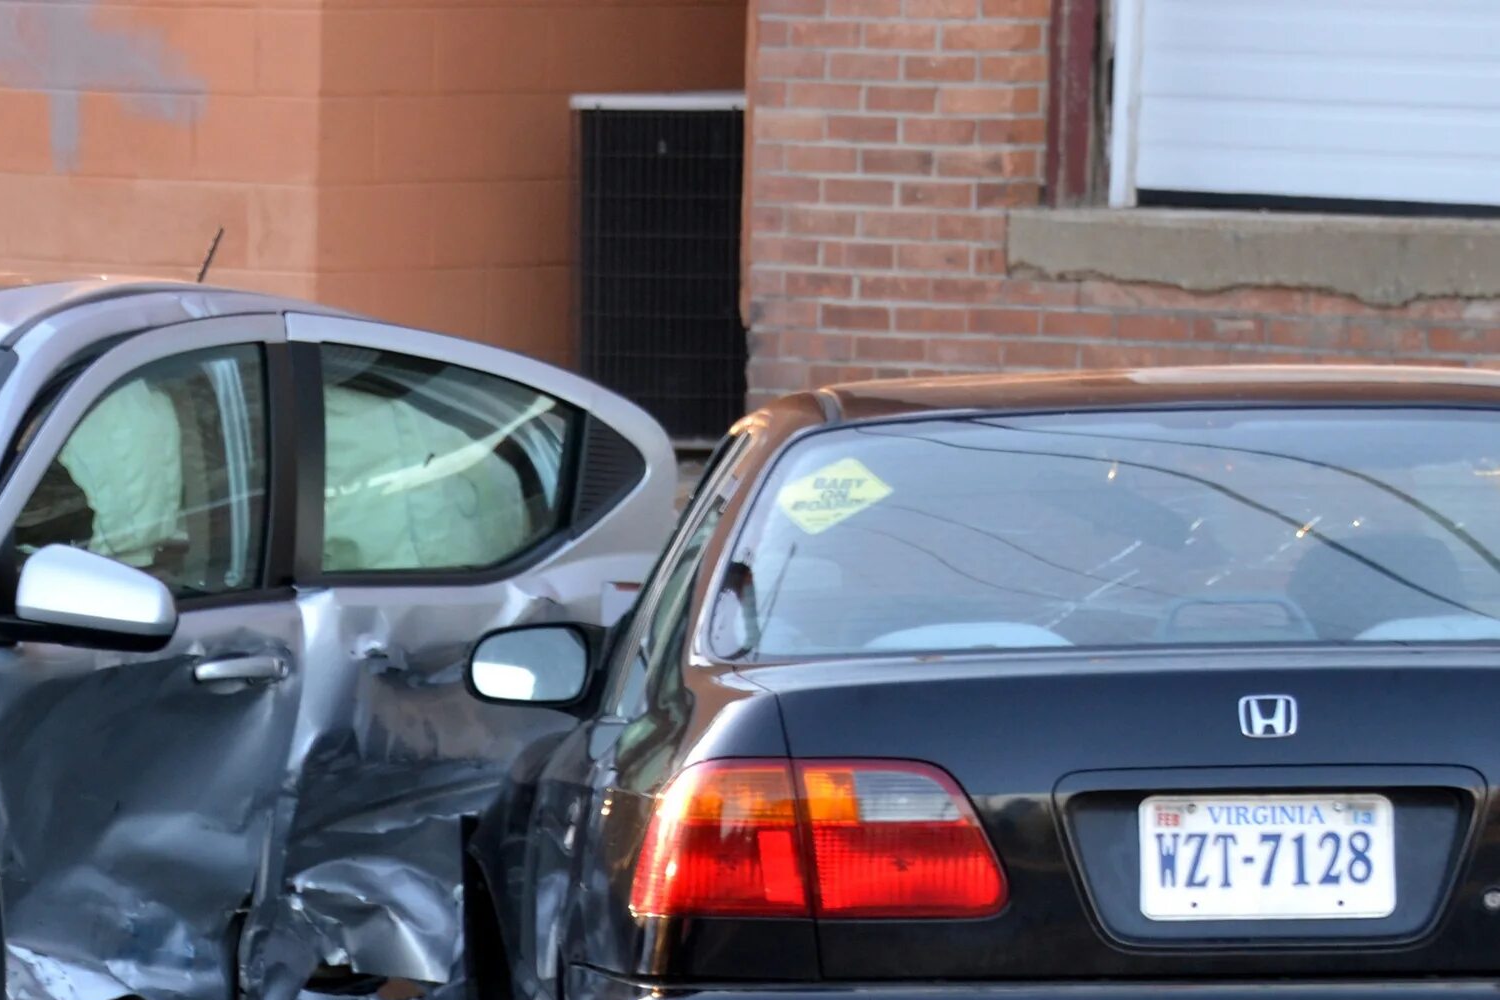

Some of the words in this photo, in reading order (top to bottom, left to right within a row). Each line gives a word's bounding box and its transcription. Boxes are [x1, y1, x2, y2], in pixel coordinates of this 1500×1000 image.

[813, 478, 868, 490] BABY
[820, 490, 849, 501] ON
[1156, 813, 1181, 827] FEB
[1206, 804, 1326, 825] VIRGINIA
[1155, 830, 1374, 888] WZT-7128
